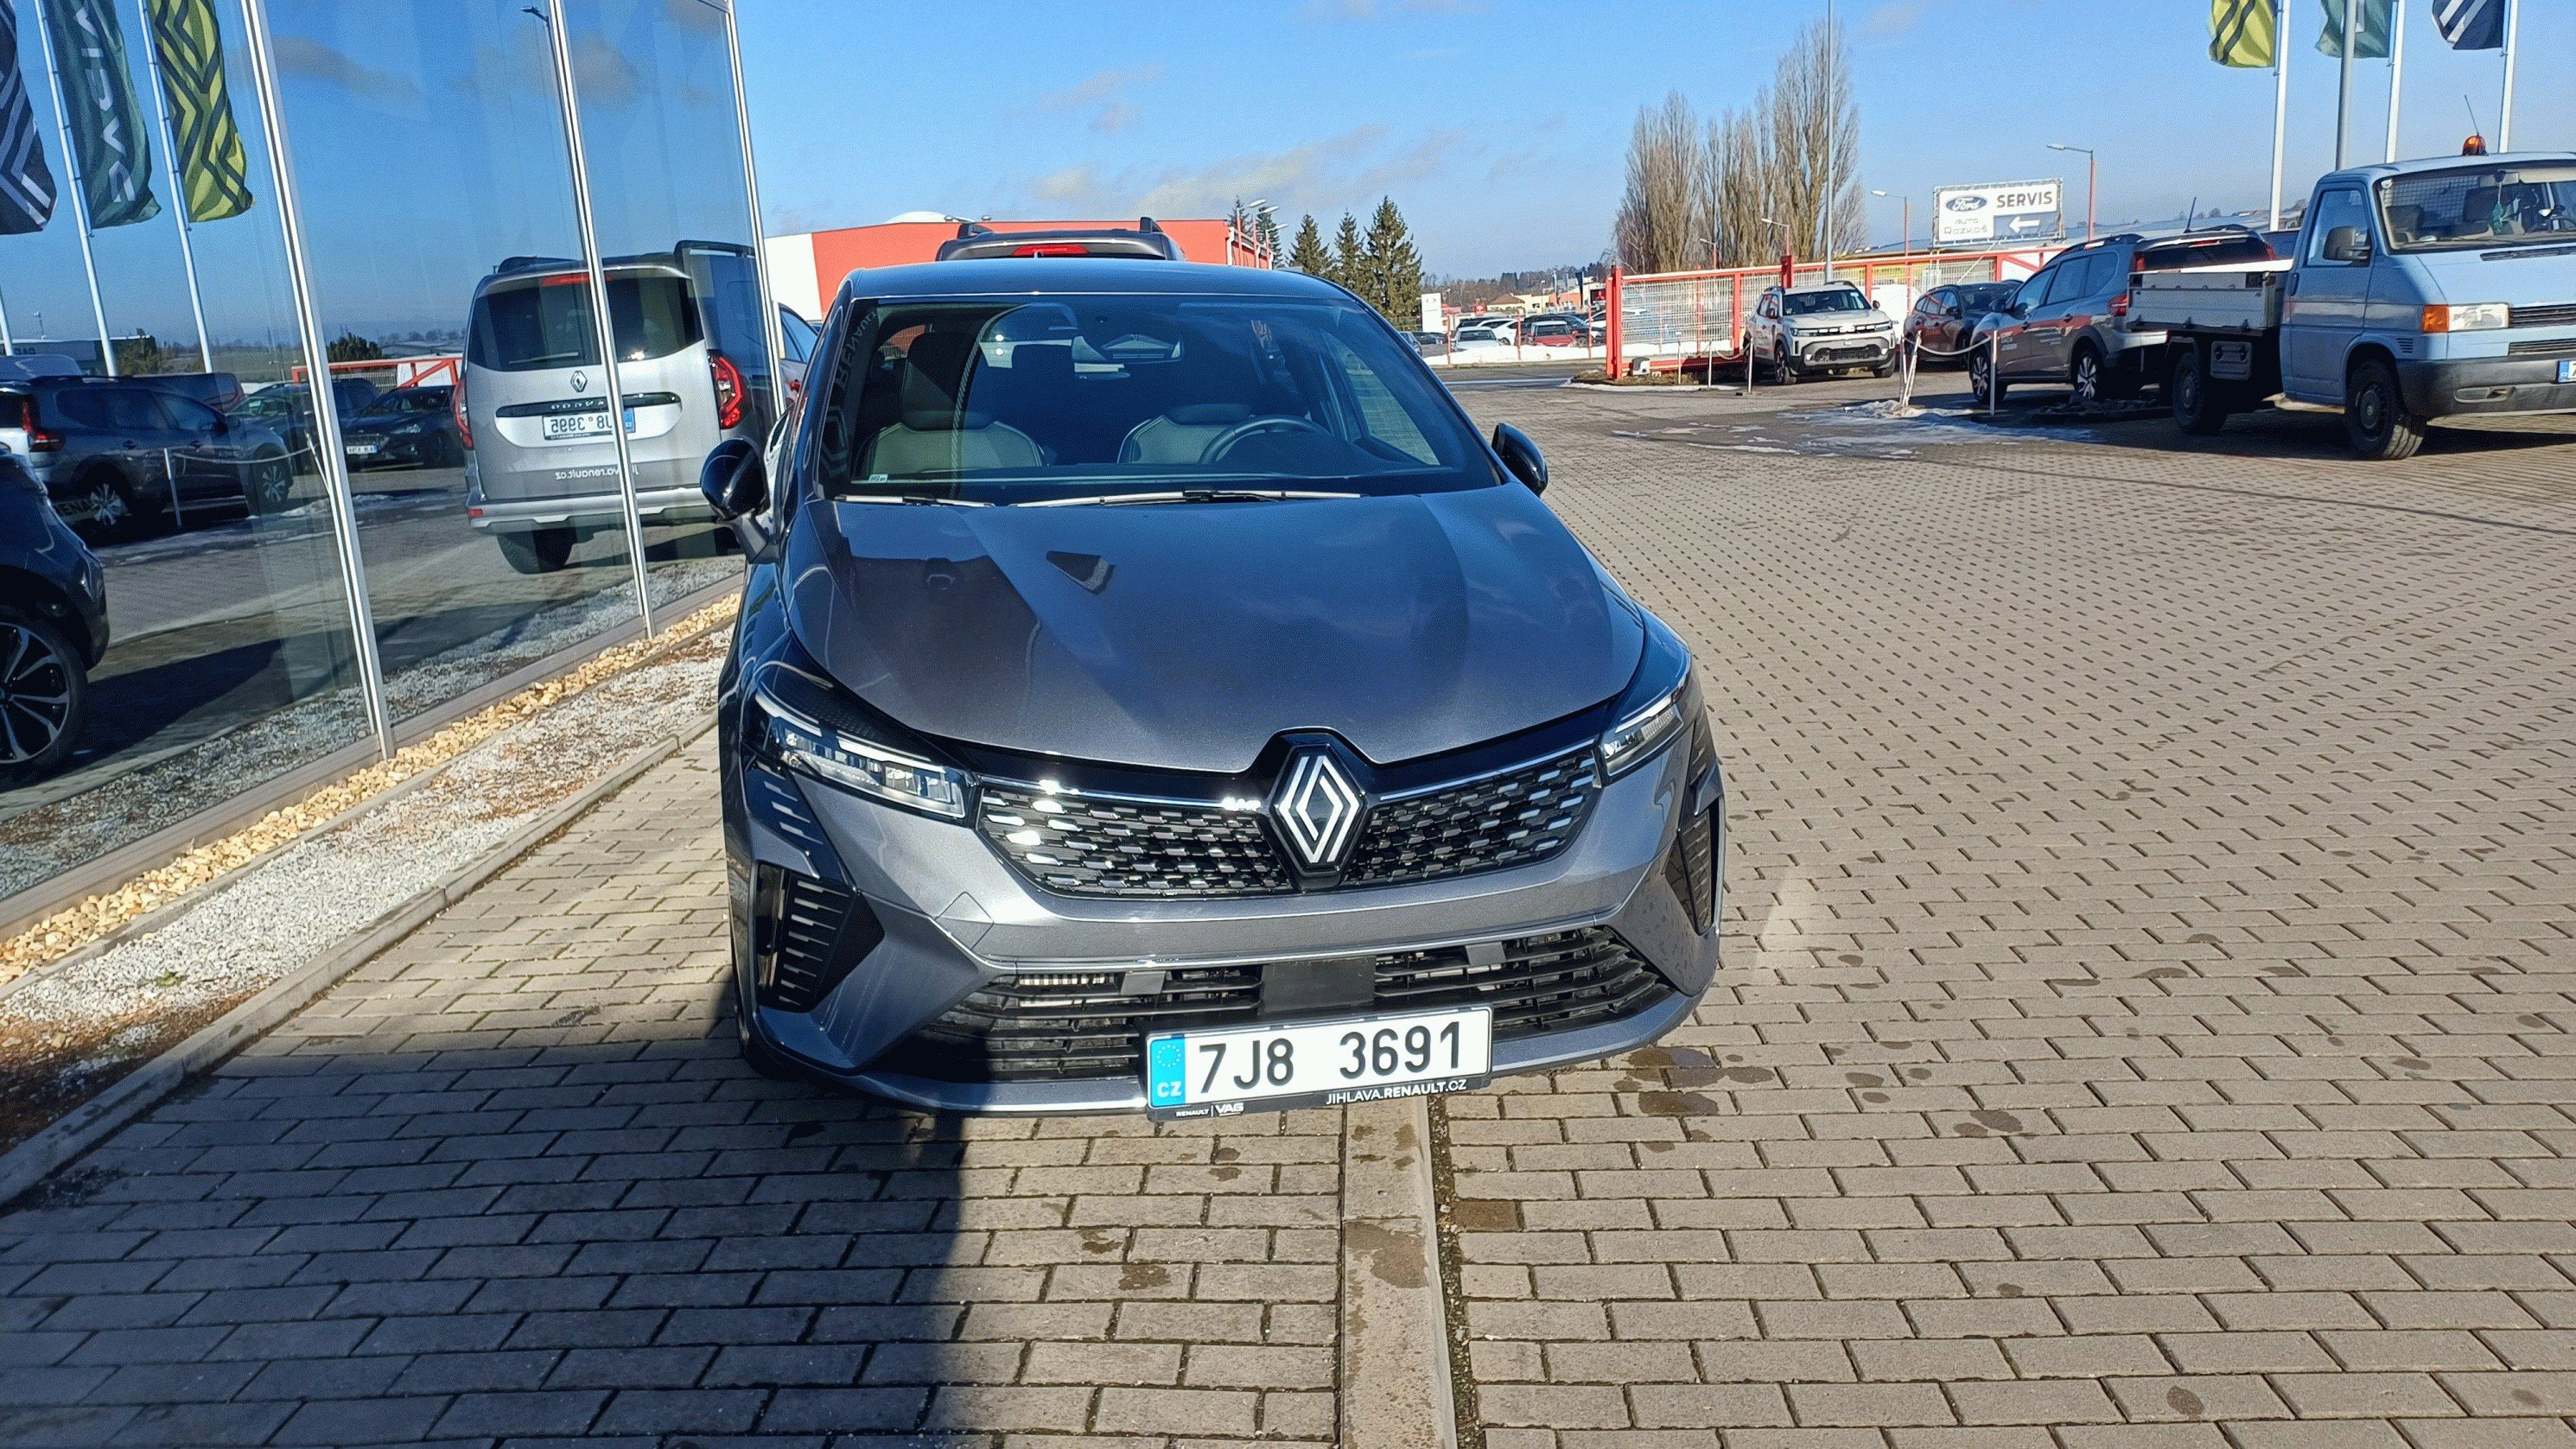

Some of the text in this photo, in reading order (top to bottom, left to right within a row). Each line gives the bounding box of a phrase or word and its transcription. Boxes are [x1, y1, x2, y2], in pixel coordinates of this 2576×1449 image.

[1951, 197, 1981, 211] Ford
[1996, 191, 2052, 208] SERVIS
[1199, 1020, 1460, 1094] 7J8 3691
[1156, 1081, 1182, 1098] CZ
[1326, 1078, 1467, 1106] JIHLAVA.RENAULT.CZ
[1175, 1108, 1210, 1118] RENAULT
[1215, 1102, 1245, 1115] VAG
